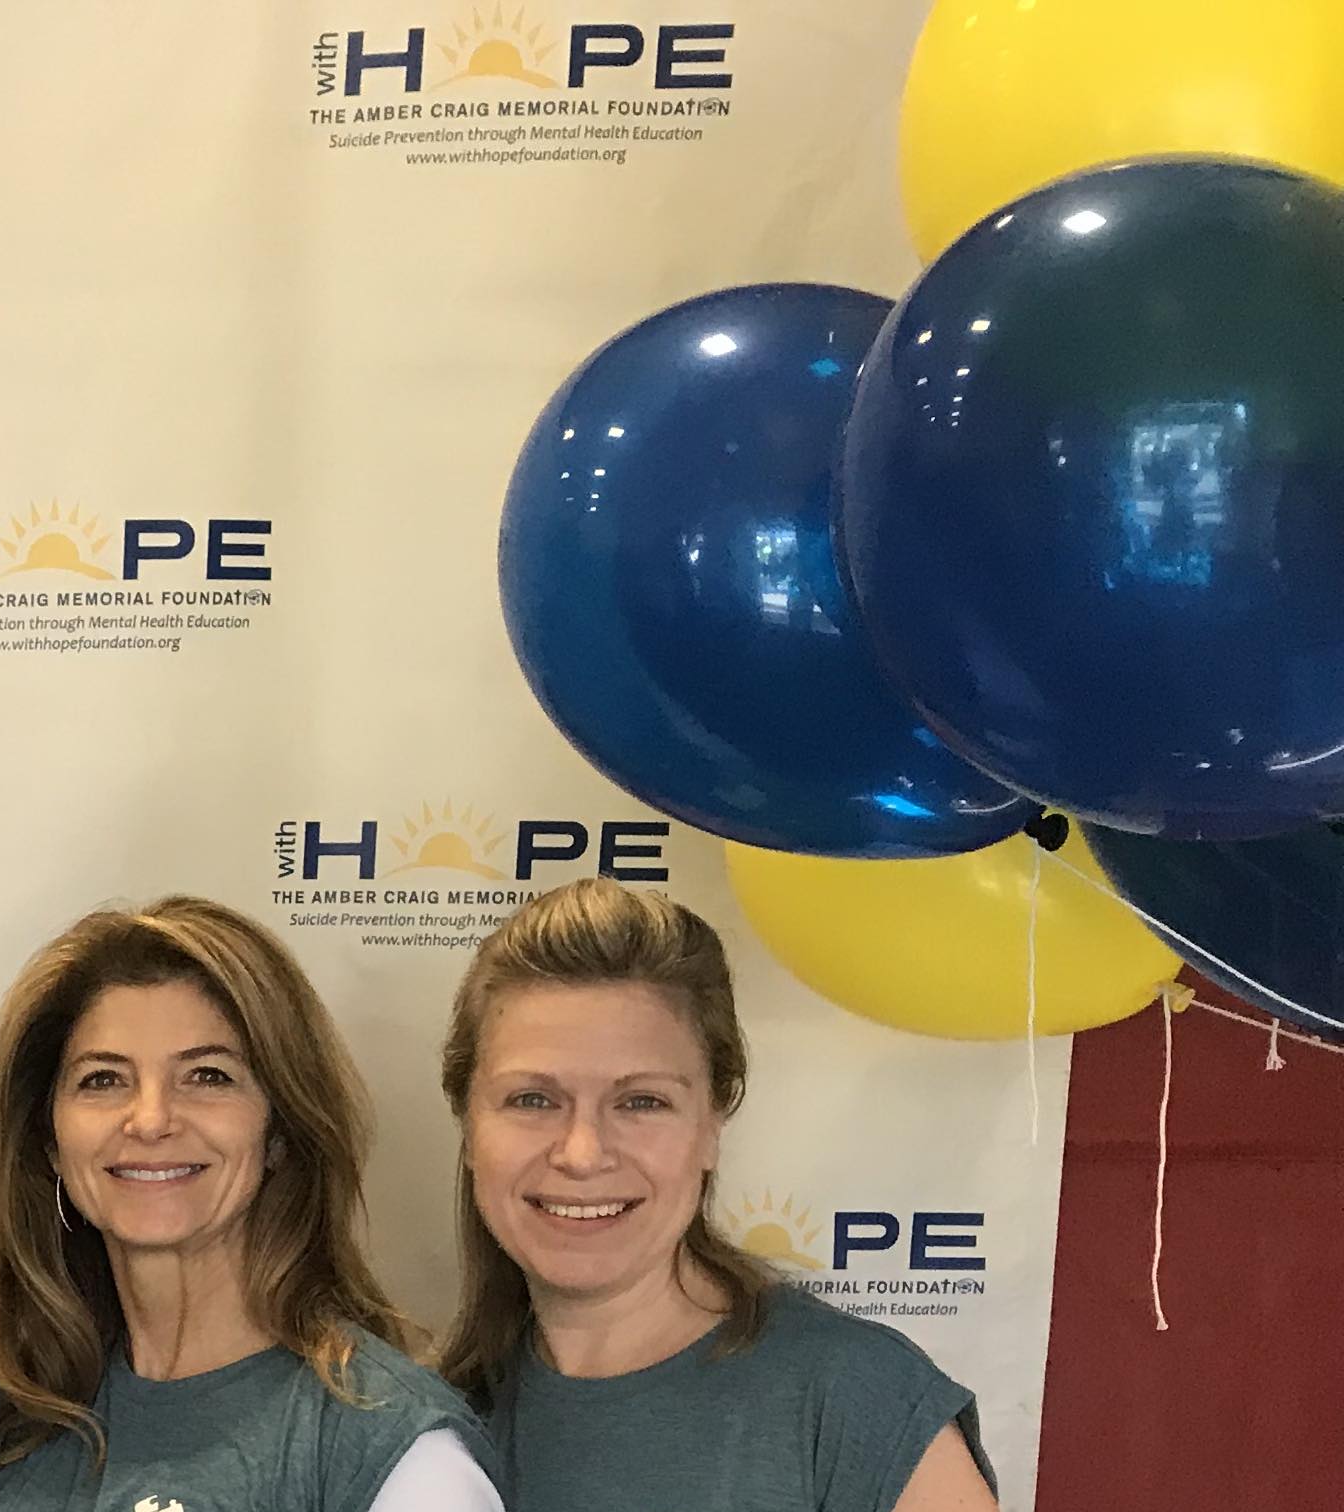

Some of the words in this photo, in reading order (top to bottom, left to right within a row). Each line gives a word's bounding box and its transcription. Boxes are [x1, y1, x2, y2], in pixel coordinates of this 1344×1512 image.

[312, 33, 338, 96] with
[310, 109, 345, 124] THE
[353, 104, 422, 122] AMBER
[430, 103, 489, 118] CRAIG
[498, 100, 599, 116] MEMORIAL
[608, 98, 730, 116] FOUNDATION
[329, 132, 381, 148] Suicide
[384, 128, 463, 144] Prevention
[468, 126, 526, 145] through
[530, 124, 581, 140] Mental
[584, 125, 629, 139] Health
[633, 126, 703, 140] Education
[406, 146, 628, 165] www.withhopefoundation.org
[58, 592, 153, 606] MEMORIAL
[162, 589, 271, 606] FOUNDATION
[29, 616, 84, 633] through
[88, 615, 137, 629] Mental
[140, 614, 183, 628] Health
[187, 614, 250, 628] Education
[274, 822, 296, 878] with
[272, 891, 304, 904] THE
[312, 891, 376, 904] AMBER
[384, 890, 438, 904] CRAIG
[289, 913, 338, 926] Suicide
[340, 913, 415, 926] Prevention
[419, 913, 476, 930] through
[867, 1279, 984, 1294] FOUNDATION
[890, 1302, 958, 1316] Education
